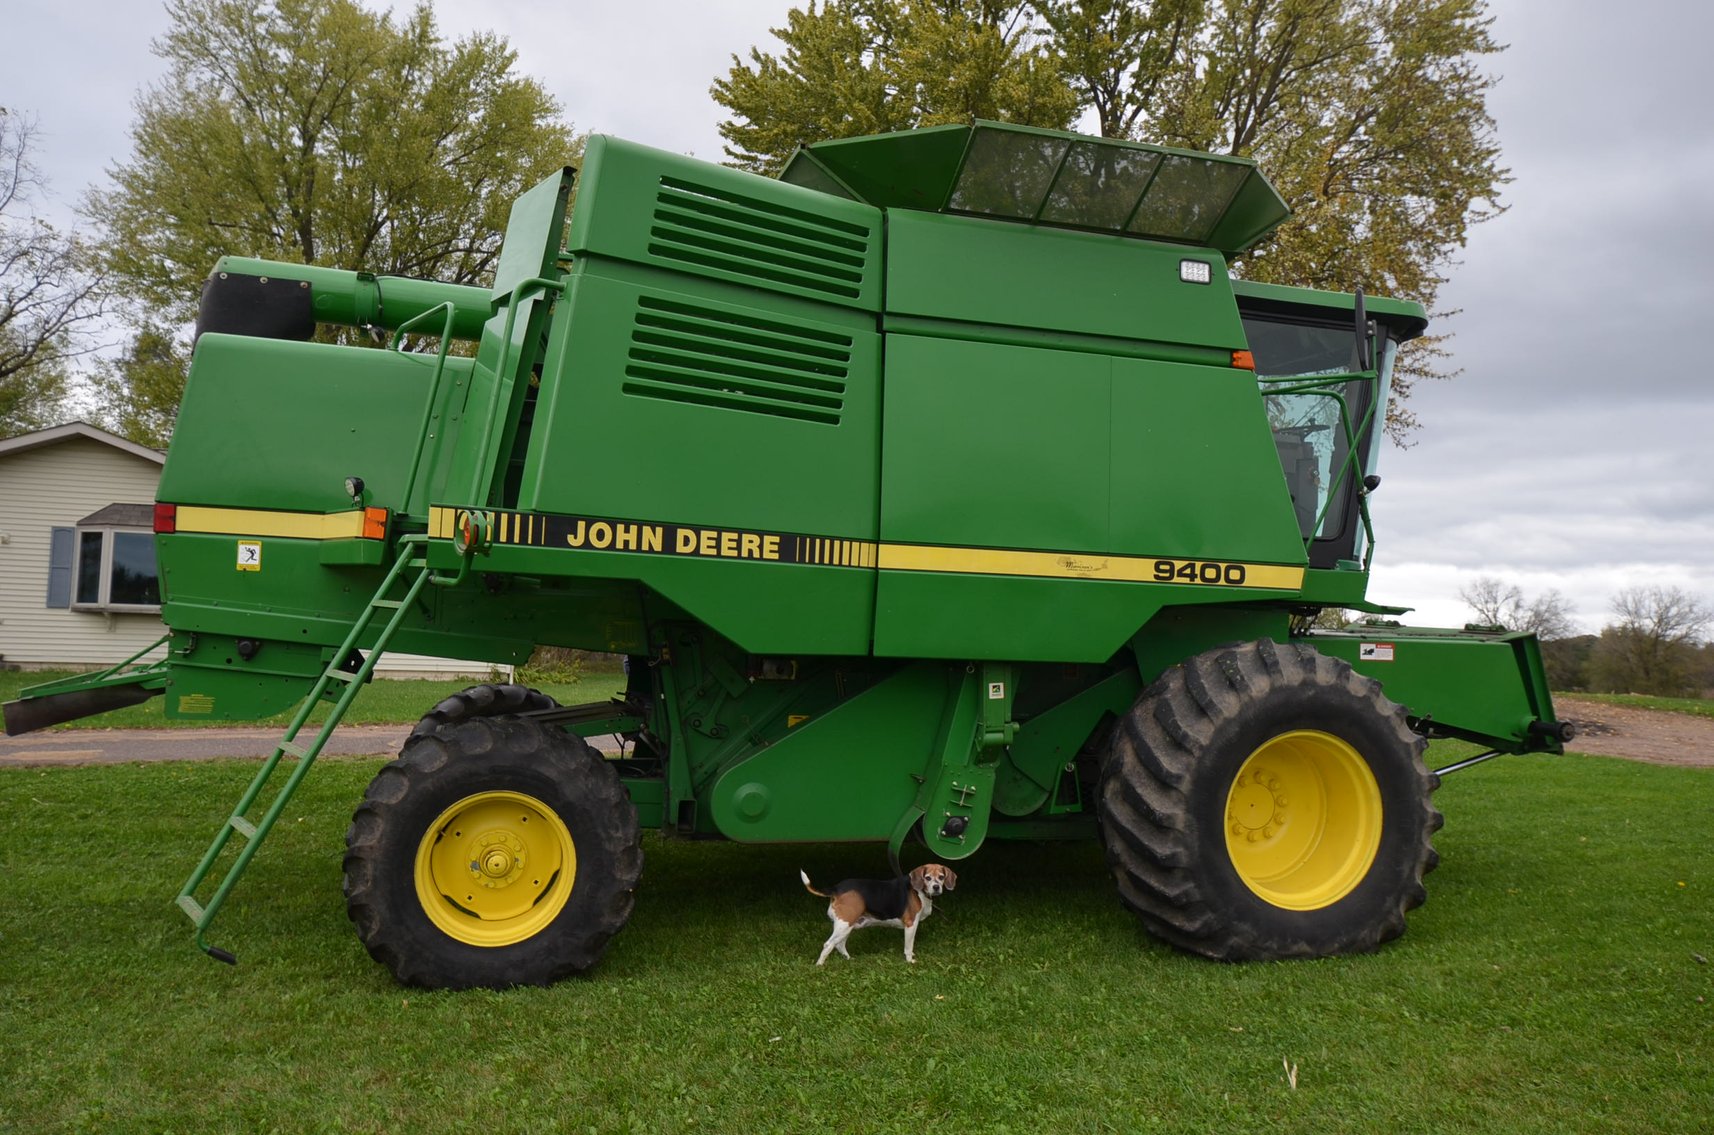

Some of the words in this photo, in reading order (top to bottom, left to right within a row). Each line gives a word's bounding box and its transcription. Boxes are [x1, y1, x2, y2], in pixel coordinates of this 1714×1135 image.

[567, 521, 662, 552] JOHN
[676, 529, 780, 559] DEERE
[1154, 561, 1246, 584] 9400
